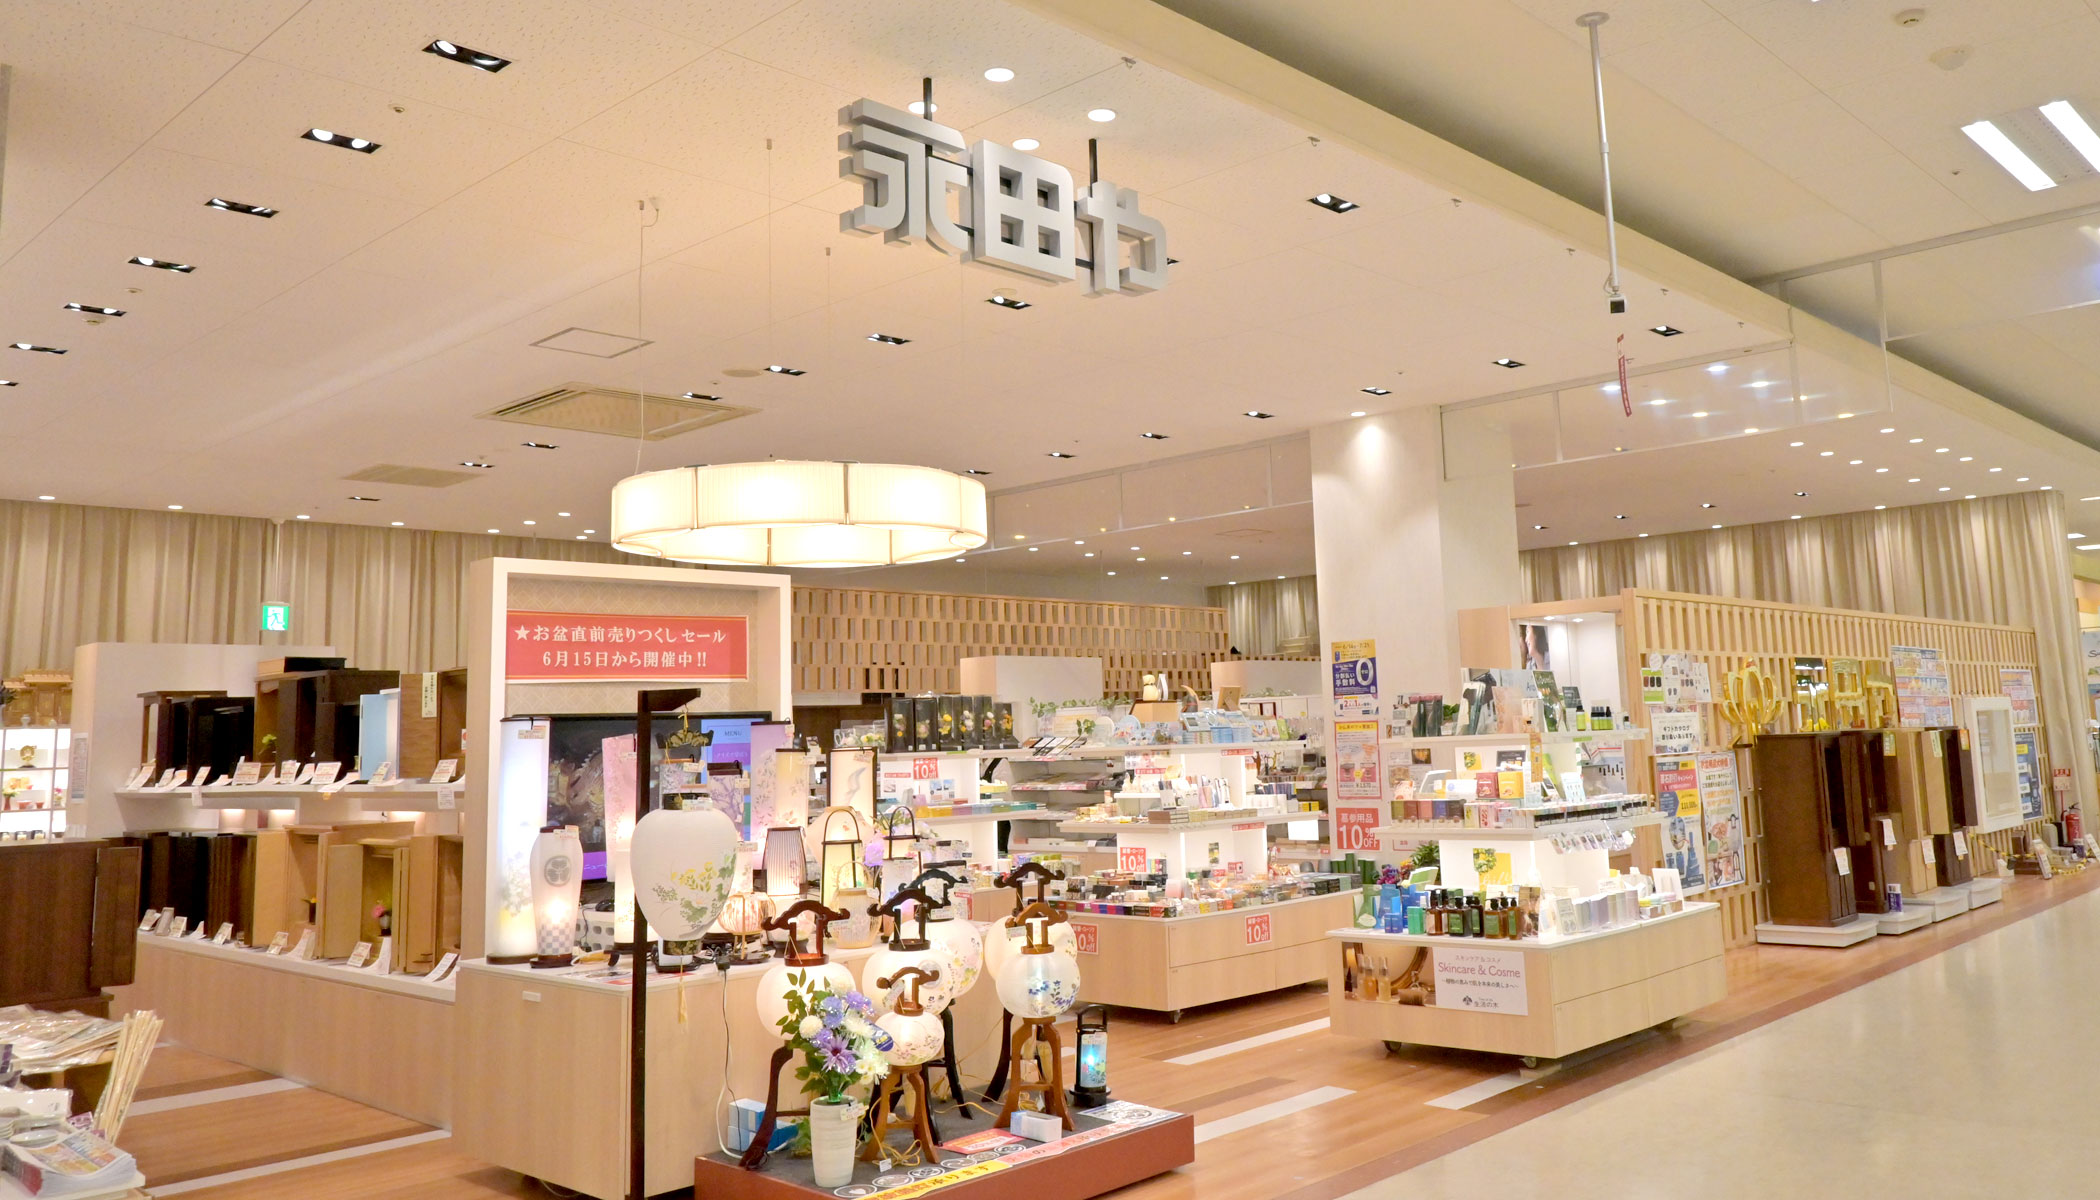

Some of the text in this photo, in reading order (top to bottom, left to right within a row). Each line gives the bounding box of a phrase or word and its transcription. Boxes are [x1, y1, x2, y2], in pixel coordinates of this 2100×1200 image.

[533, 624, 727, 644] お盆直前売りつくしセール
[1341, 813, 1374, 824] 墓参用品
[1363, 837, 1378, 848] OFF
[1438, 962, 1520, 978] Skincare & Cosme
